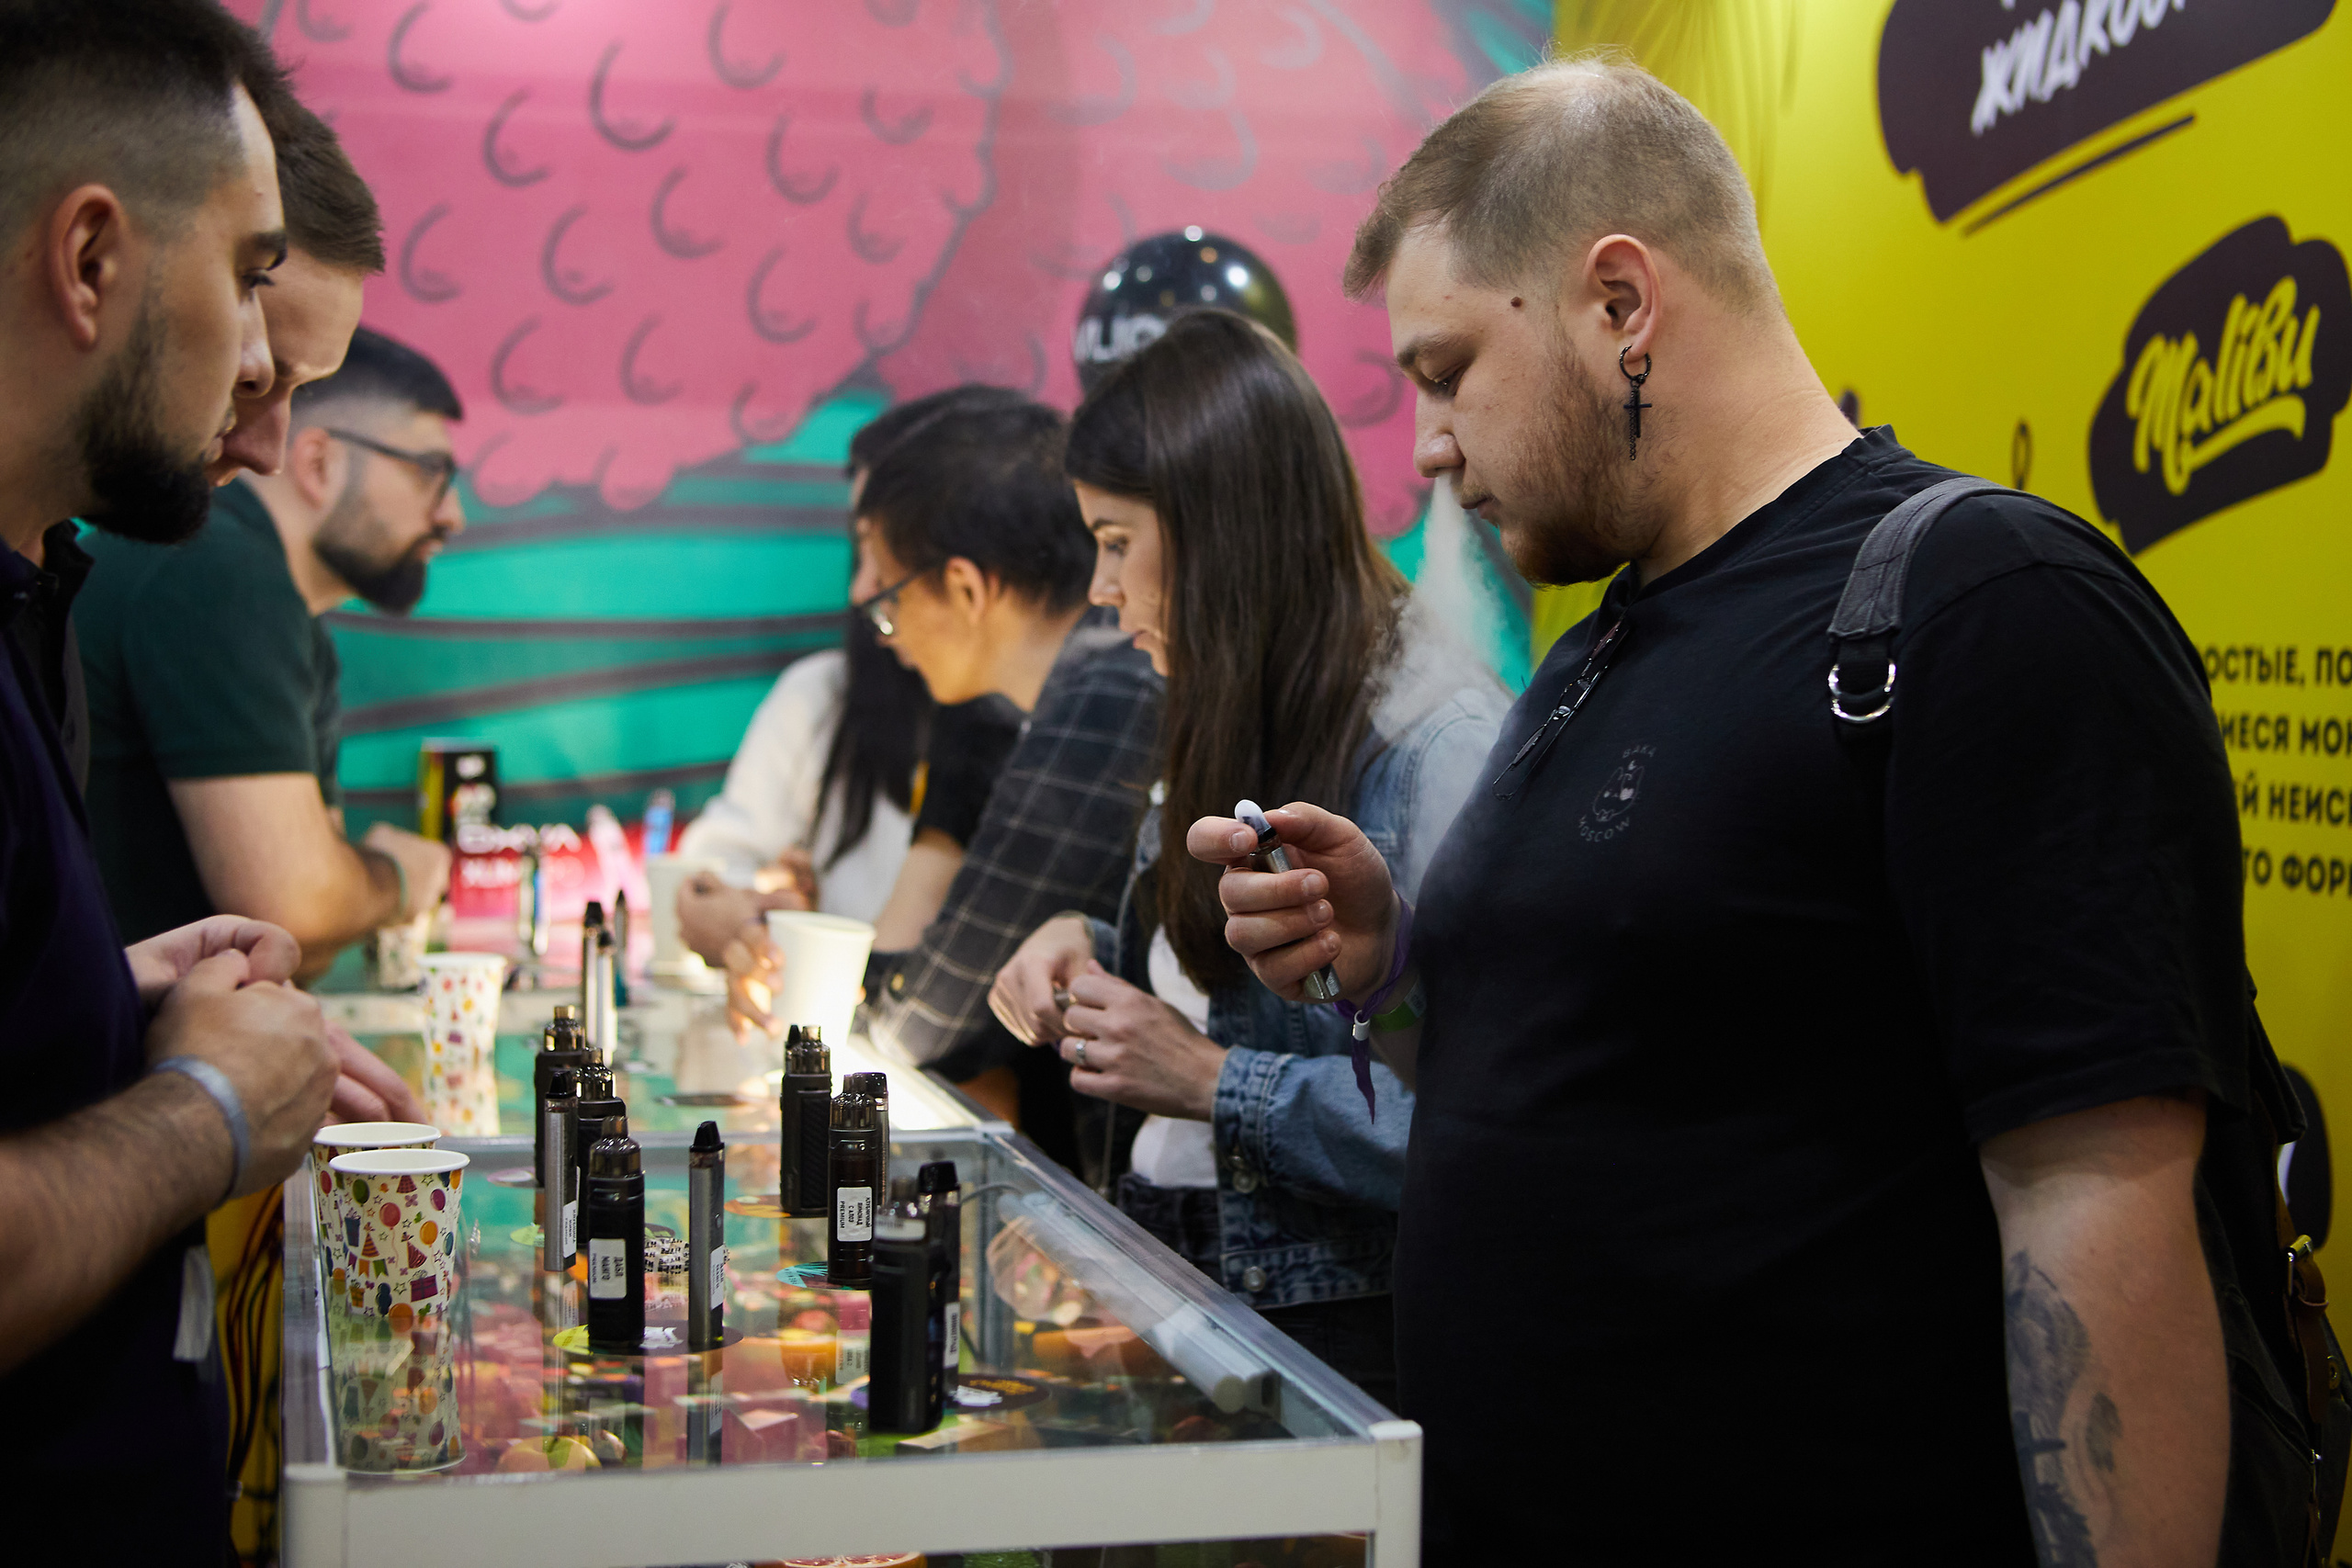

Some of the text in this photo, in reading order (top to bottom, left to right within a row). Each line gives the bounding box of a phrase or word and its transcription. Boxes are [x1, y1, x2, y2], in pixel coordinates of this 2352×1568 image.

[2203, 646, 2305, 687] ОСТЫЕ,
[2221, 715, 2288, 753] ИЕСЯ
[1578, 816, 1630, 842] MOSCOW
